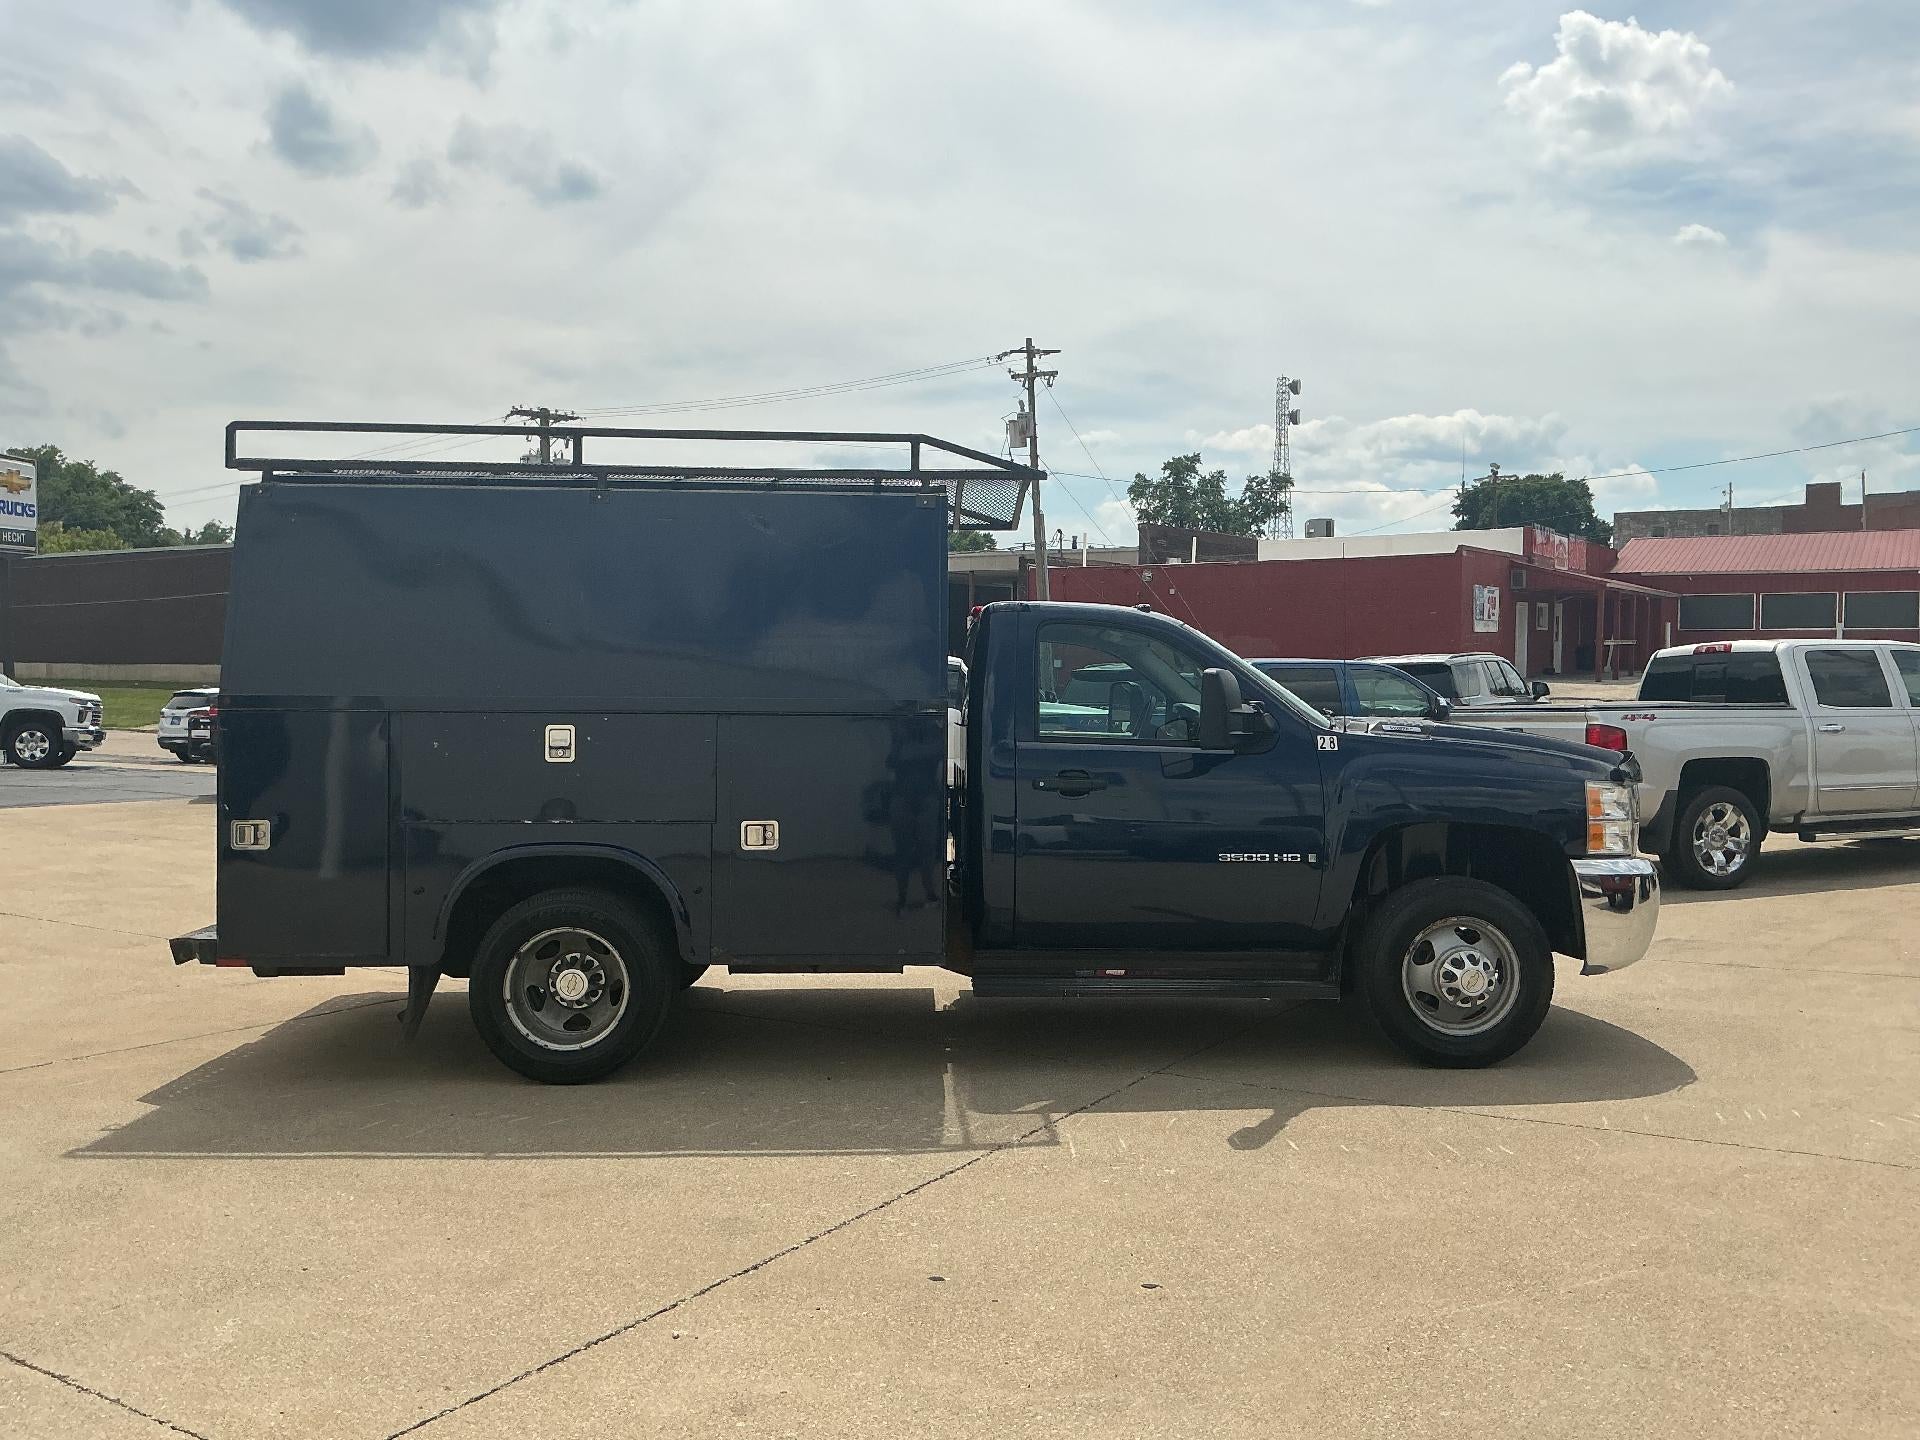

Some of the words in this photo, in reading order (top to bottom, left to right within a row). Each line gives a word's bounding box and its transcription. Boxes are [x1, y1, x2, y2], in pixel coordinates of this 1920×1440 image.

[2, 531, 26, 543] HECHT
[1319, 737, 1336, 750] 28
[1219, 853, 1270, 862] 3500
[1273, 853, 1301, 862] HD
